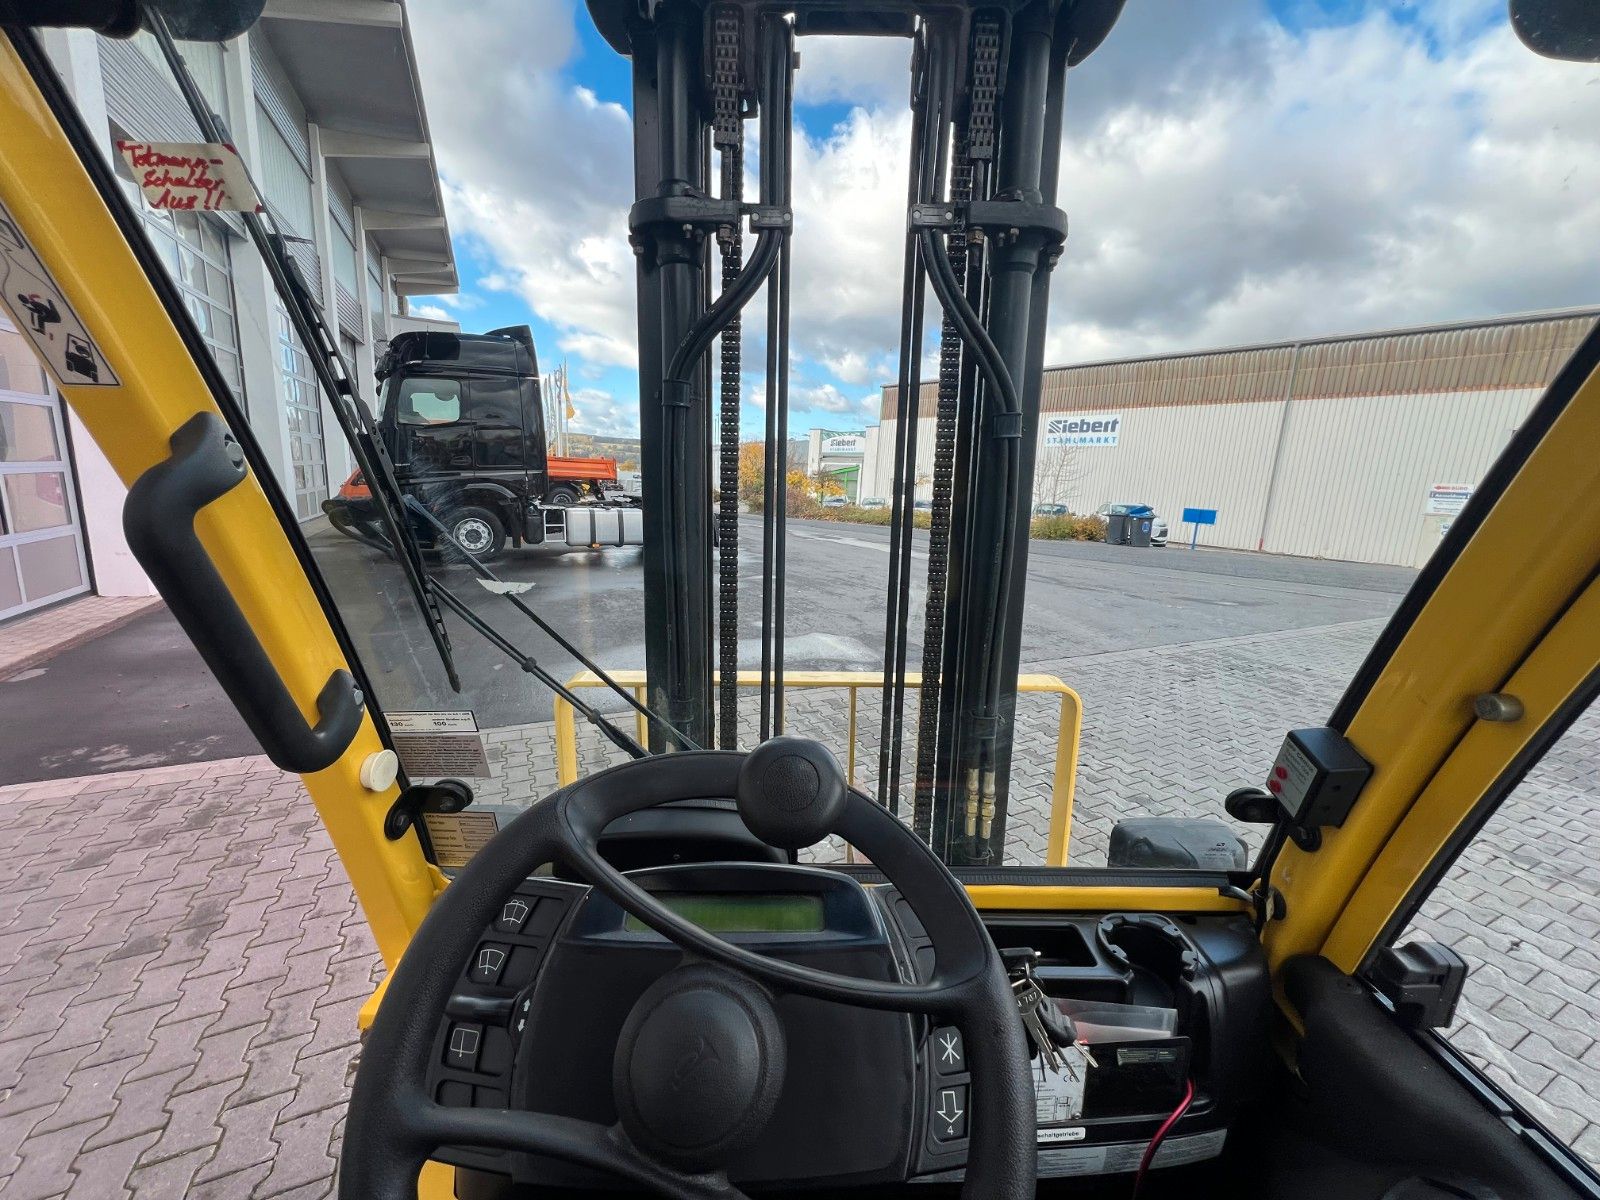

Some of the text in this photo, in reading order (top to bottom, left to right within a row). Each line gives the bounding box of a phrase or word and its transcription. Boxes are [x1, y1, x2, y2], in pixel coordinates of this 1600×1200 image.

[1047, 418, 1119, 434] Siebert
[830, 439, 856, 447] Siebert
[1046, 435, 1117, 445] STAHLMARKT
[947, 1125, 954, 1136] 4
